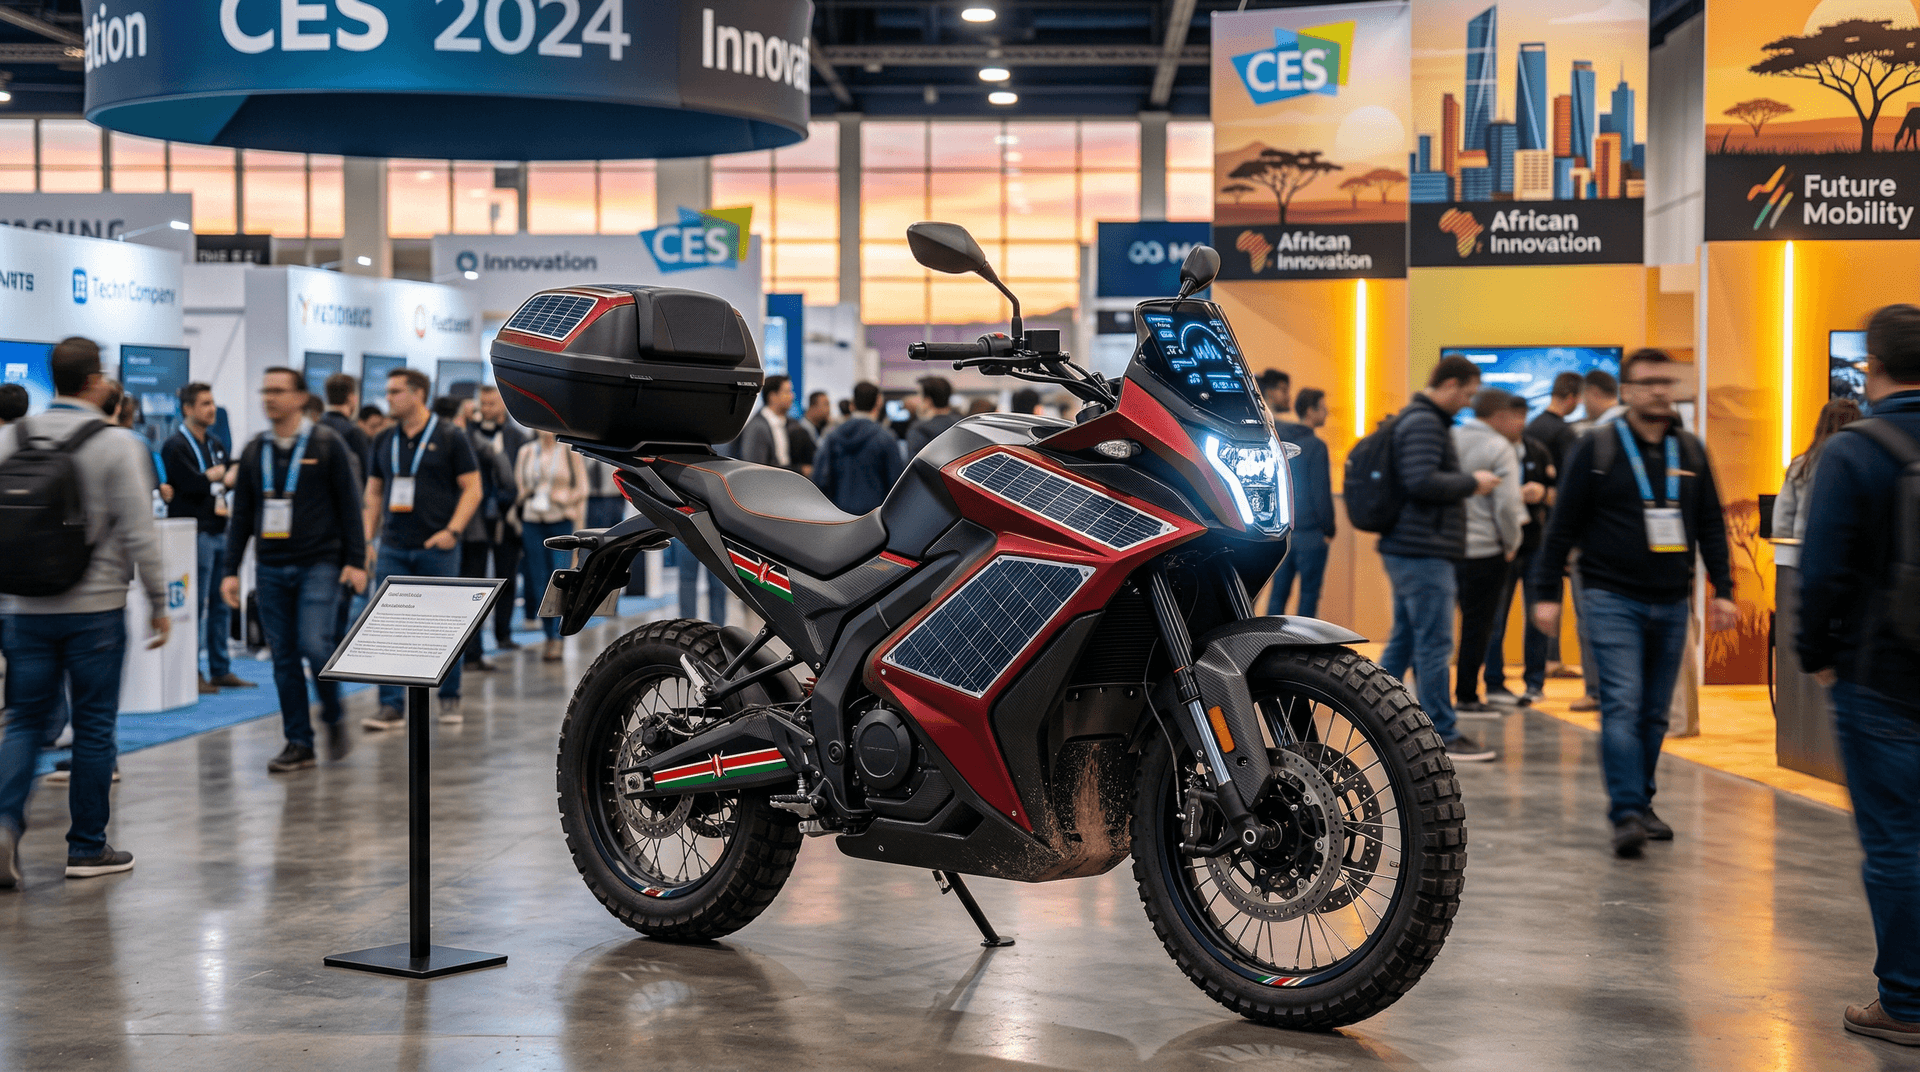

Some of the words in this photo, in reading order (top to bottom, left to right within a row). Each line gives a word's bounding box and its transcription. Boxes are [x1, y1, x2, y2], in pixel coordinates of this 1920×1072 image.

[219, 0, 389, 54] CES
[434, 0, 631, 60] 2024
[1246, 48, 1328, 93] CES
[1804, 174, 1898, 198] Future
[1490, 209, 1579, 232] African
[1803, 200, 1915, 230] Mobility
[652, 226, 729, 263] CES
[1277, 231, 1351, 251] African
[1490, 232, 1601, 254] Innovation
[484, 250, 597, 272] Innovation
[1277, 250, 1373, 270] Innovation
